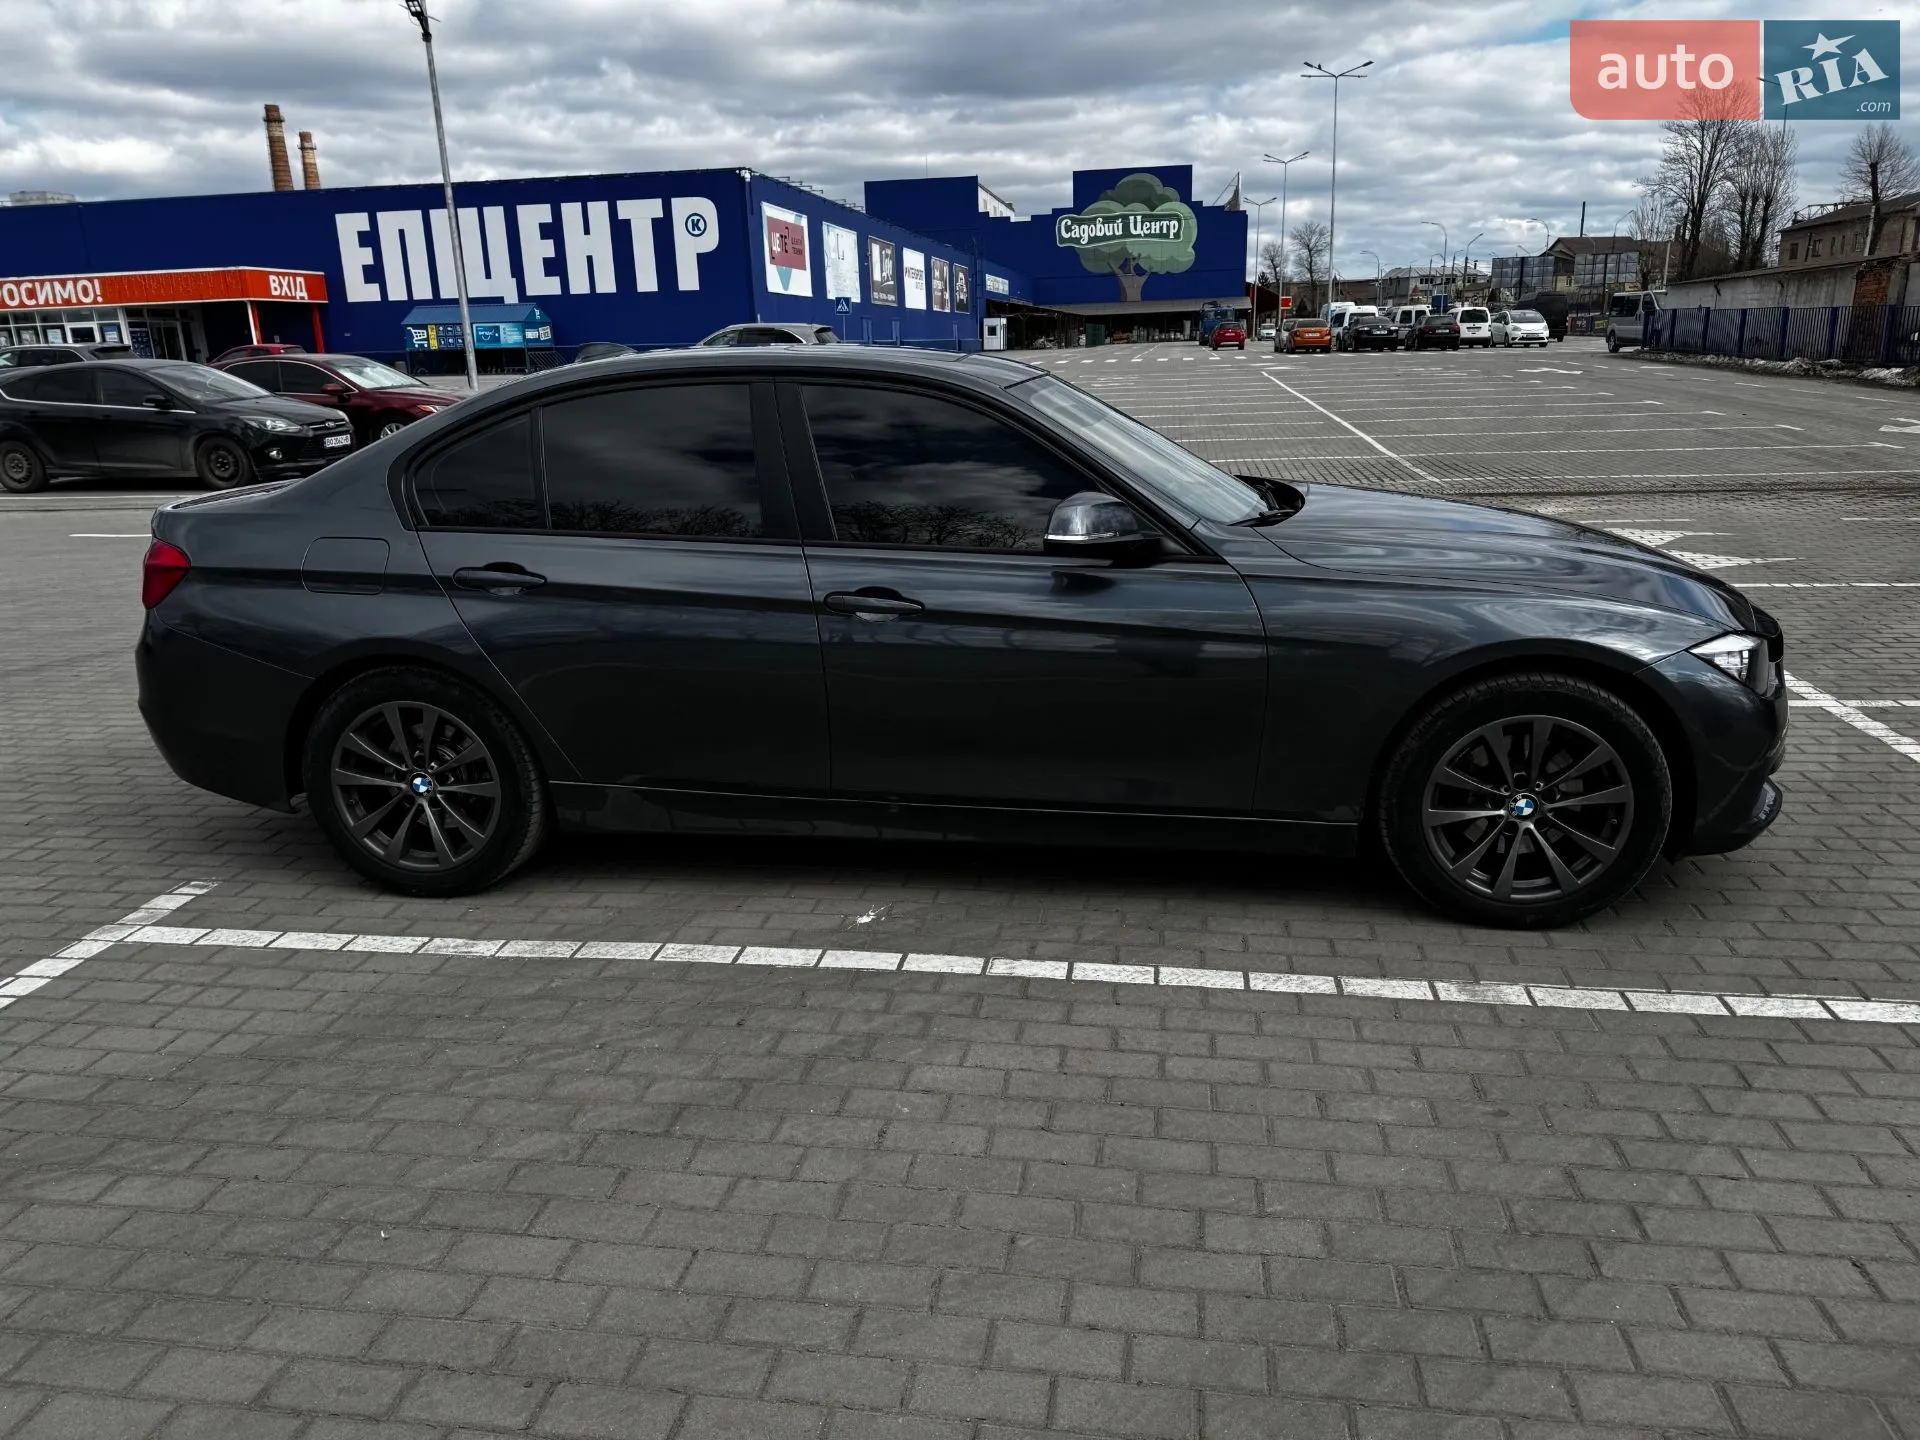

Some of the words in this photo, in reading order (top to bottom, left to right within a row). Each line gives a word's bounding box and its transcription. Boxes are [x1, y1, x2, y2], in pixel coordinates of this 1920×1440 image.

[1060, 217, 1123, 244] Садовий
[1128, 215, 1179, 239] Центр
[335, 196, 719, 304] ЕПІЦЕНТР
[0, 279, 103, 307] ОСИМО!
[269, 275, 308, 300] ВХІД
